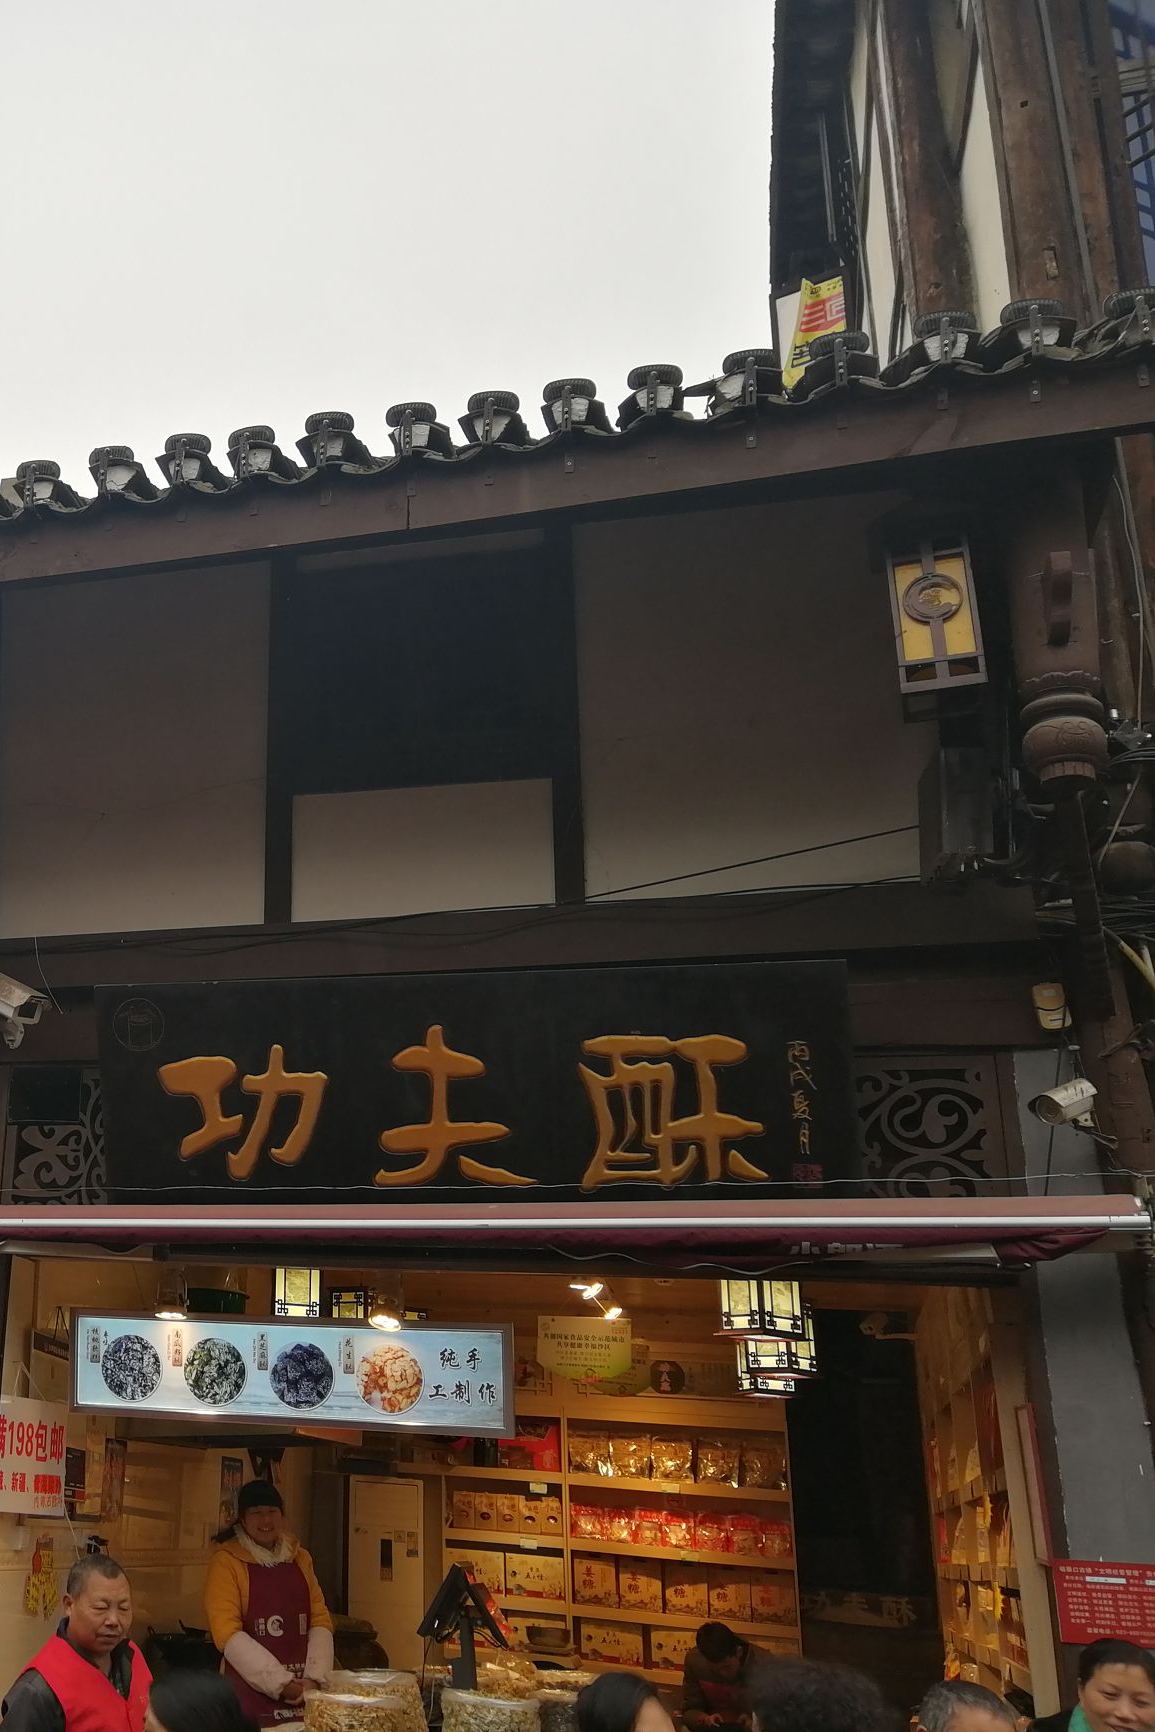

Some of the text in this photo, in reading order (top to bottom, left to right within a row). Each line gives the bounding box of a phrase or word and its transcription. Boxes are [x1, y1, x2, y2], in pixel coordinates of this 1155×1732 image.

[158, 1024, 771, 1191] 功夫酥
[438, 1347, 483, 1371] 纯手
[428, 1382, 498, 1405] 工制作
